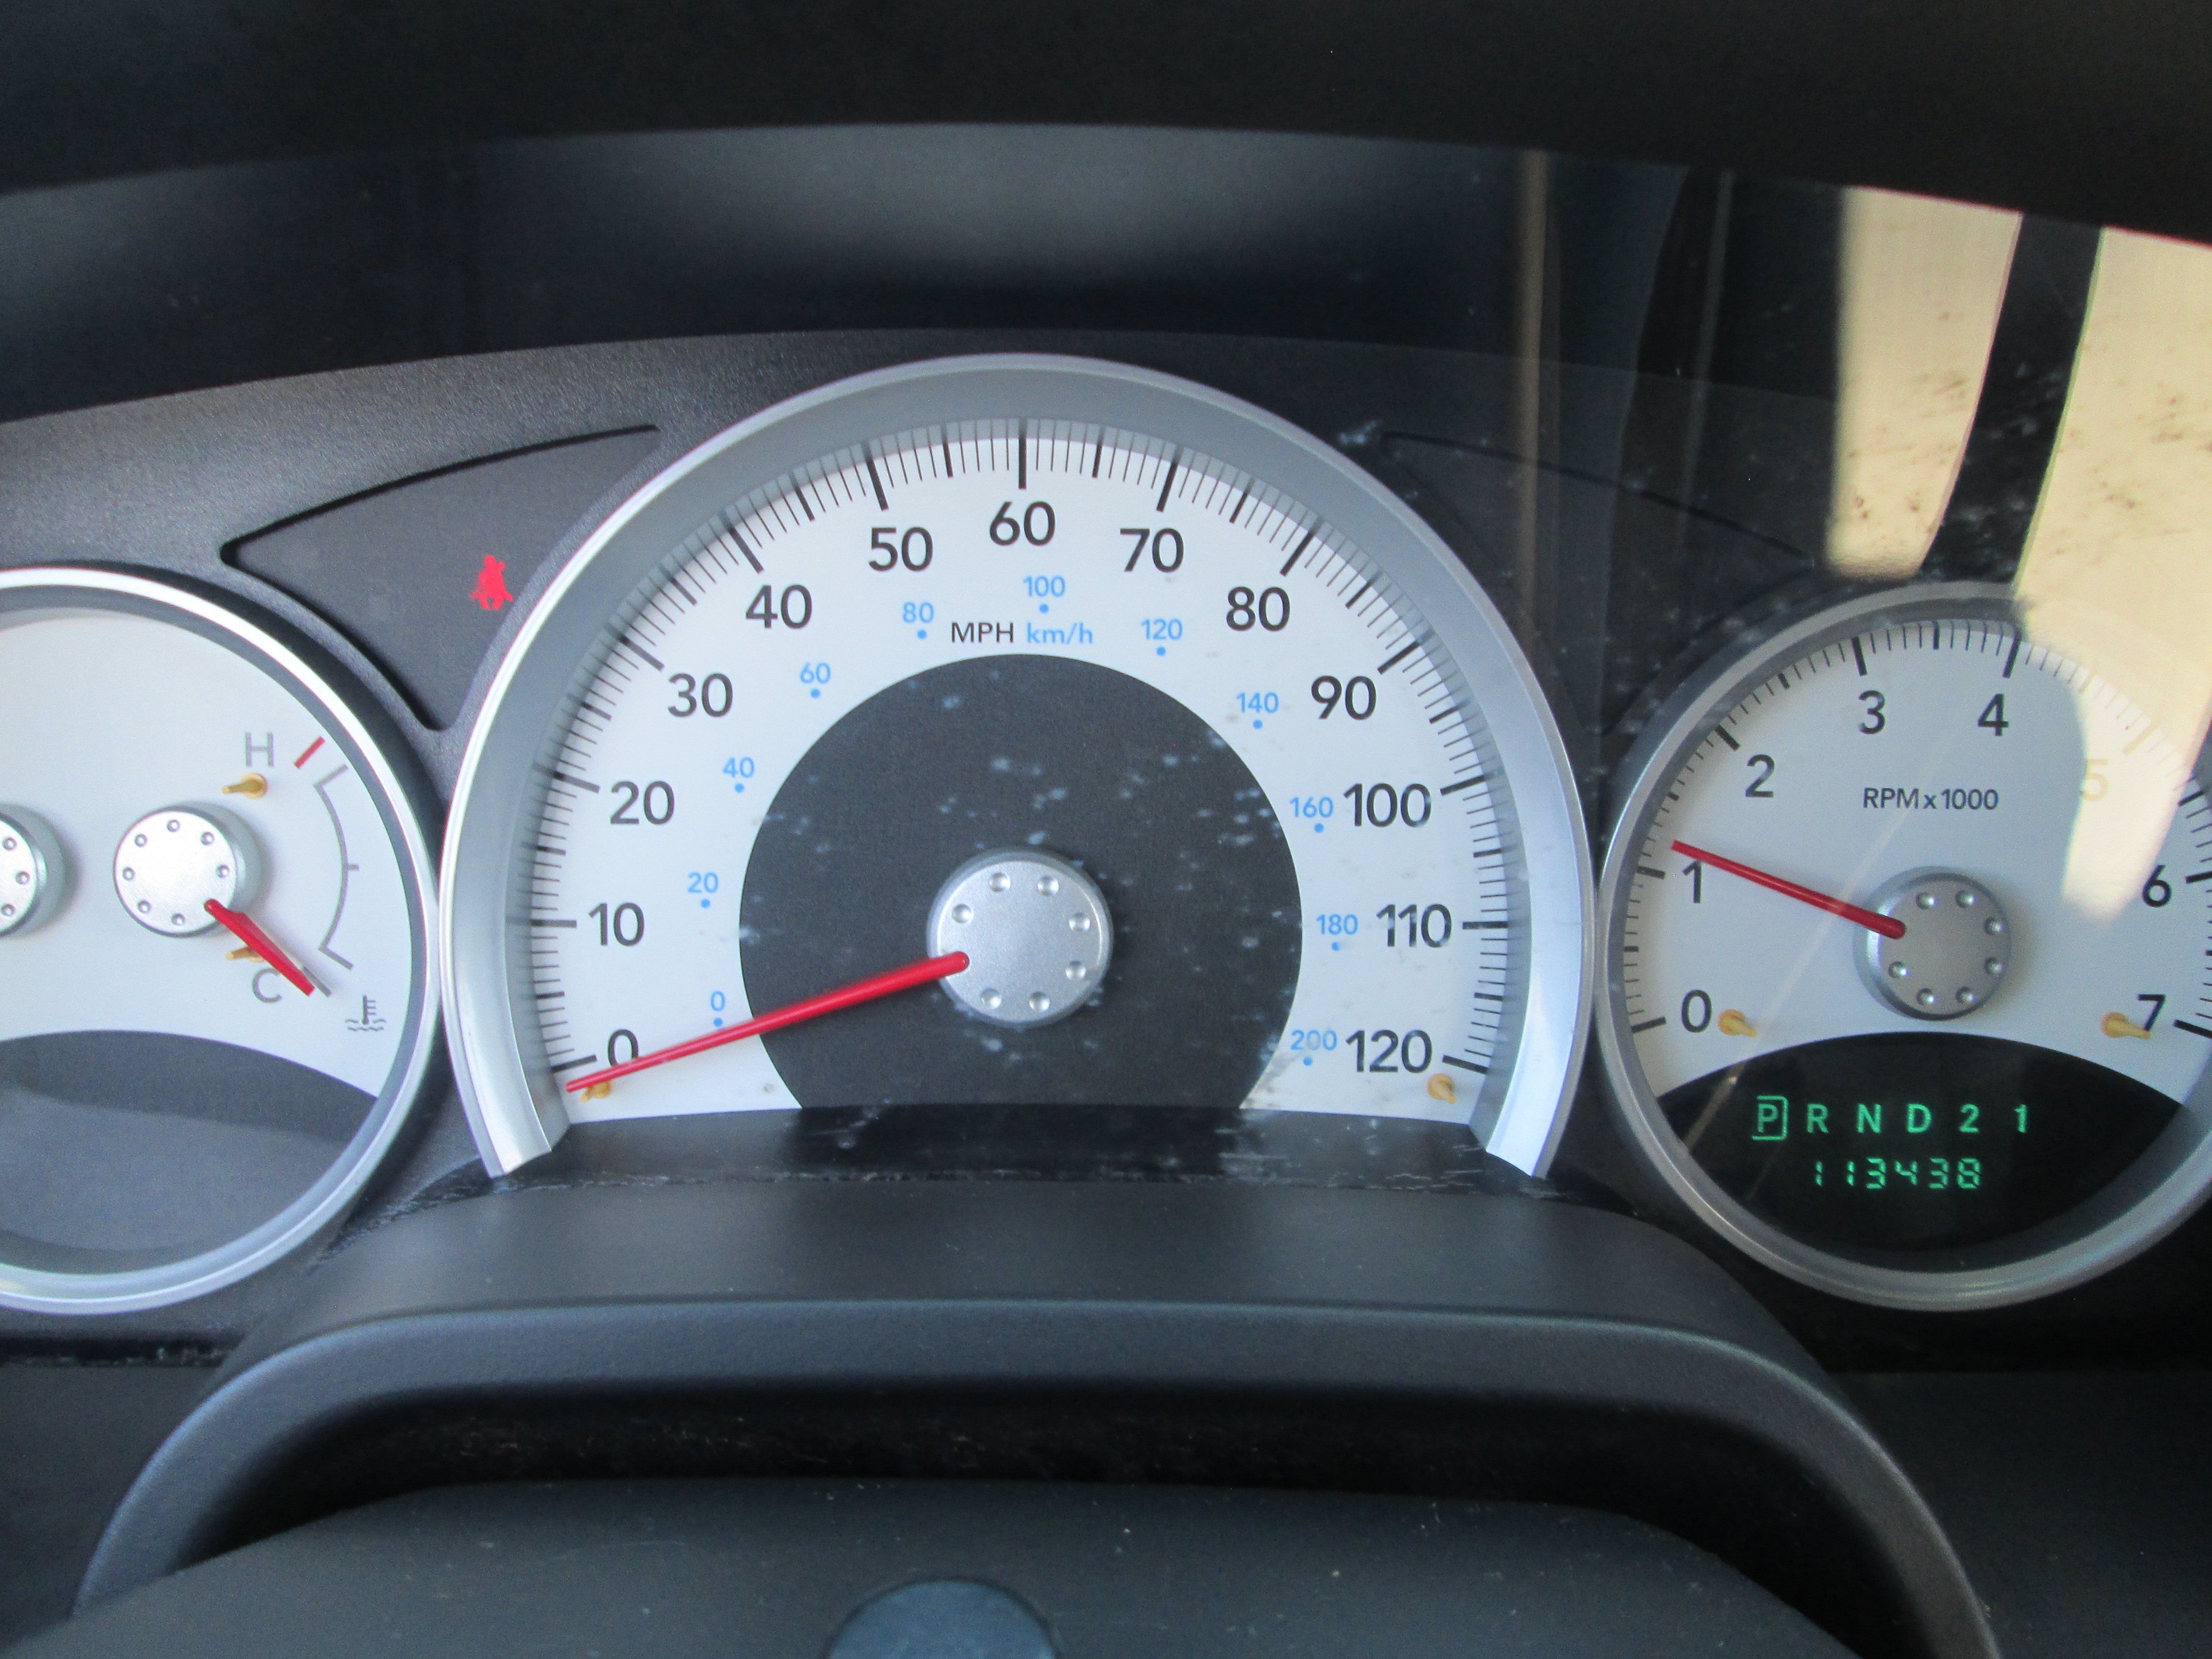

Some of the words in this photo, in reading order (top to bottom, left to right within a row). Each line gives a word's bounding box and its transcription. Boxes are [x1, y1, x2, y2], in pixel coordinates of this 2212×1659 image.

[989, 501, 1056, 546] 60
[868, 527, 933, 572] 50
[1119, 528, 1184, 572] 70
[745, 584, 812, 629] 40
[1023, 576, 1065, 598] 100
[1225, 586, 1291, 631] 80
[902, 601, 934, 623] 80
[951, 622, 1014, 643] MPH
[1027, 622, 1093, 645] km/h
[1141, 619, 1183, 640] 120
[800, 662, 830, 684] 60
[668, 673, 733, 717] 30
[1236, 692, 1279, 714] 140
[1310, 675, 1376, 720] 90
[1858, 690, 1886, 735] 3
[1977, 693, 2010, 737] 4
[245, 733, 274, 767] H
[722, 757, 754, 778] 40
[1745, 754, 1775, 798] 2
[2081, 758, 2110, 802] 5
[610, 781, 674, 824] 20
[1289, 796, 1334, 818] 160
[1344, 783, 1432, 828] 100
[688, 872, 719, 893] 20
[1683, 860, 1702, 904] 1
[2142, 864, 2172, 908] 6
[588, 902, 645, 947] 10
[1316, 914, 1358, 935] 180
[1376, 904, 1452, 948] 110
[252, 970, 282, 1002] C
[710, 991, 726, 1011] 0
[1681, 989, 1713, 1033] 0
[2137, 994, 2167, 1032] 7
[607, 1029, 639, 1067] 0
[1290, 1030, 1337, 1051] 200
[1346, 1030, 1433, 1073] 120
[1757, 1103, 1779, 1133] P
[1806, 1103, 1829, 1134] R
[1856, 1103, 1882, 1134] N
[1906, 1103, 1933, 1133] D
[1959, 1103, 1980, 1134] 2
[2014, 1103, 2028, 1134] 1
[1815, 1157, 1981, 1189] 113438
